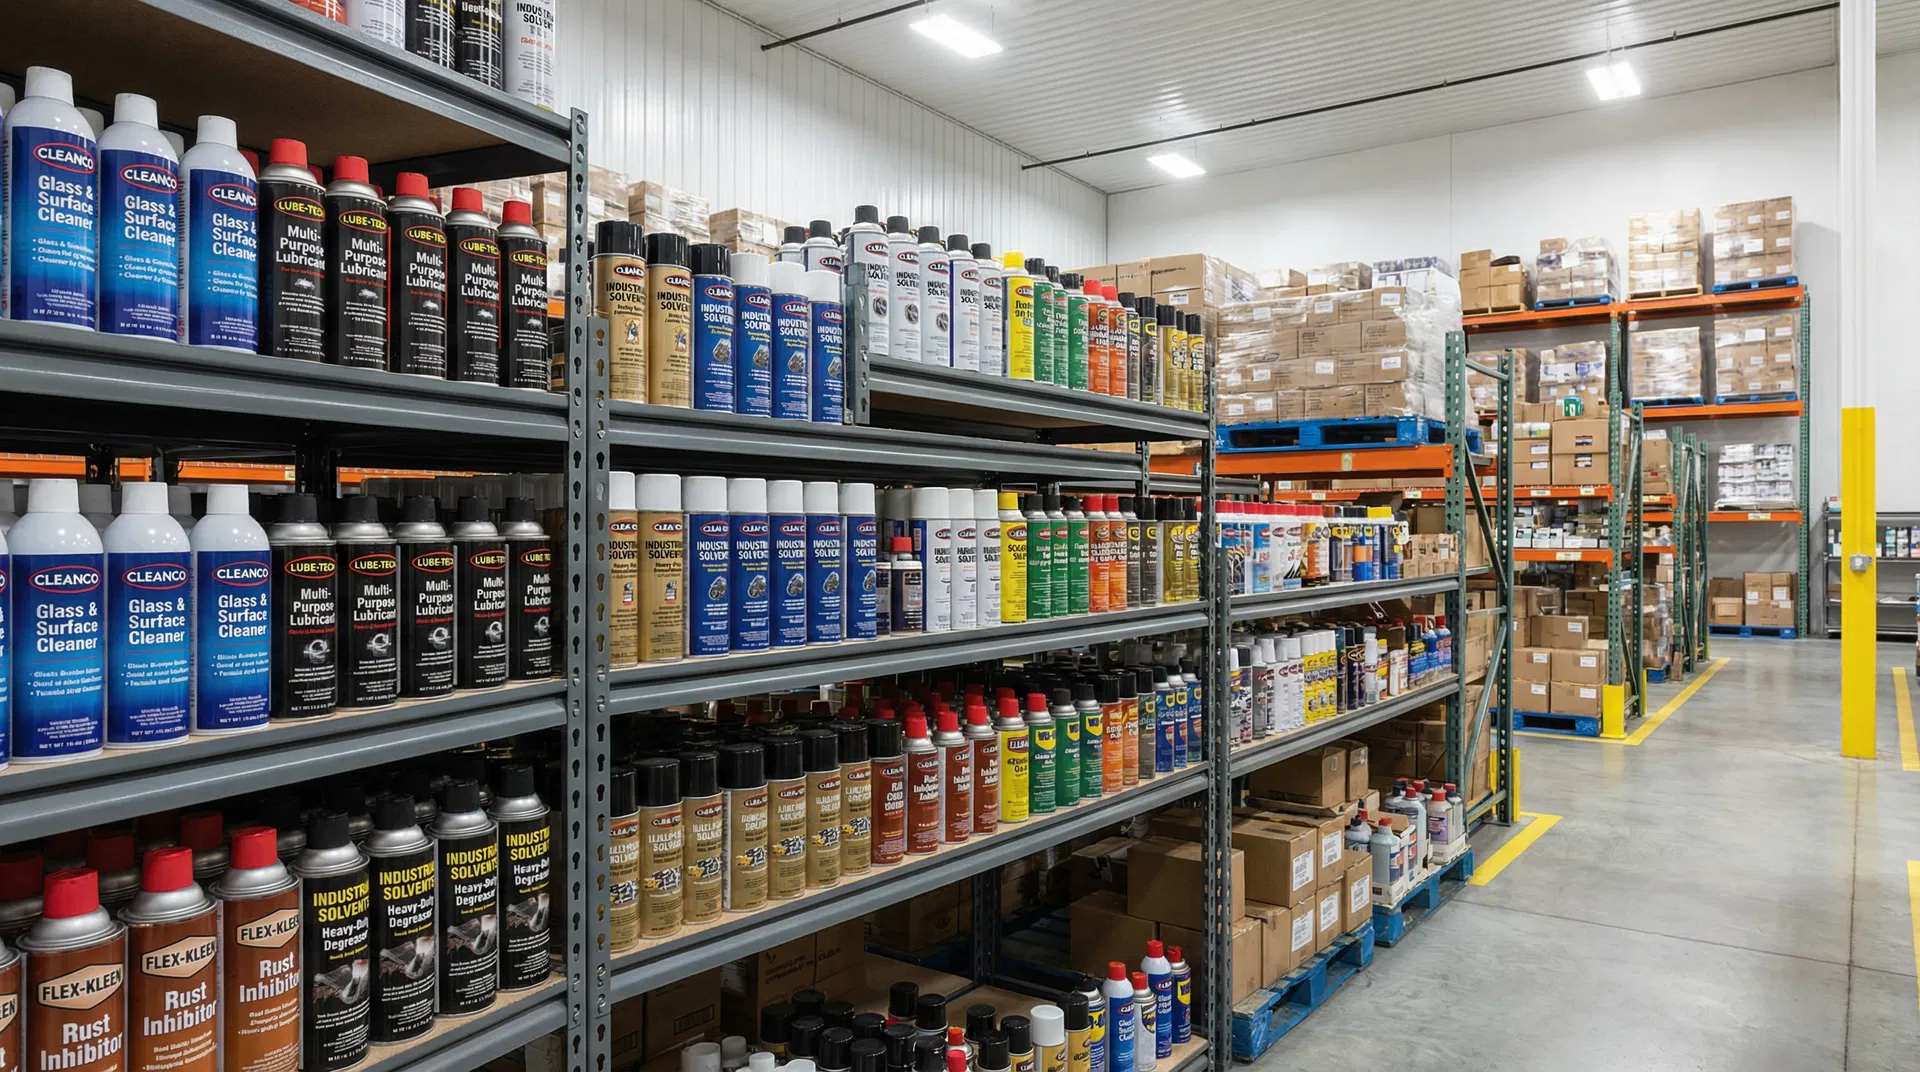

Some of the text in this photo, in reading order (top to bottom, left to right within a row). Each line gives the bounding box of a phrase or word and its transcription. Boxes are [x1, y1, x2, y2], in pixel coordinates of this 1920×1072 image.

[38, 147, 94, 170] CLEANCO
[38, 174, 93, 200] Glass &
[124, 169, 178, 189] CLEANCO
[38, 191, 94, 215] Surface
[124, 195, 166, 214] Glass
[38, 207, 93, 231] Cleaner
[212, 213, 249, 231] Glass
[288, 224, 321, 242] Multi-
[352, 237, 384, 253] Multi-
[34, 573, 99, 586] CLEANCO
[127, 570, 186, 582] CLEANCO
[216, 568, 269, 579] CLEANCO
[301, 587, 332, 600] Multi-
[363, 584, 393, 596] Multi-
[128, 597, 185, 613] Glass &
[218, 593, 267, 608] Glass &
[293, 601, 335, 615] Purpose
[36, 601, 98, 619] Glass &
[218, 609, 267, 623] Surface
[36, 619, 98, 636] Surface
[128, 614, 185, 629] Surface
[128, 630, 185, 645] Cleaner
[218, 625, 267, 638] Cleaner
[36, 637, 98, 653] Cleaner
[259, 951, 295, 979] Rust
[42, 968, 121, 1001] FLEX-KLEEN
[165, 981, 207, 1011] Rust
[143, 1000, 217, 1037] Inhibitor
[62, 1013, 111, 1045] Rust
[40, 1032, 123, 1071] Inhibitor
